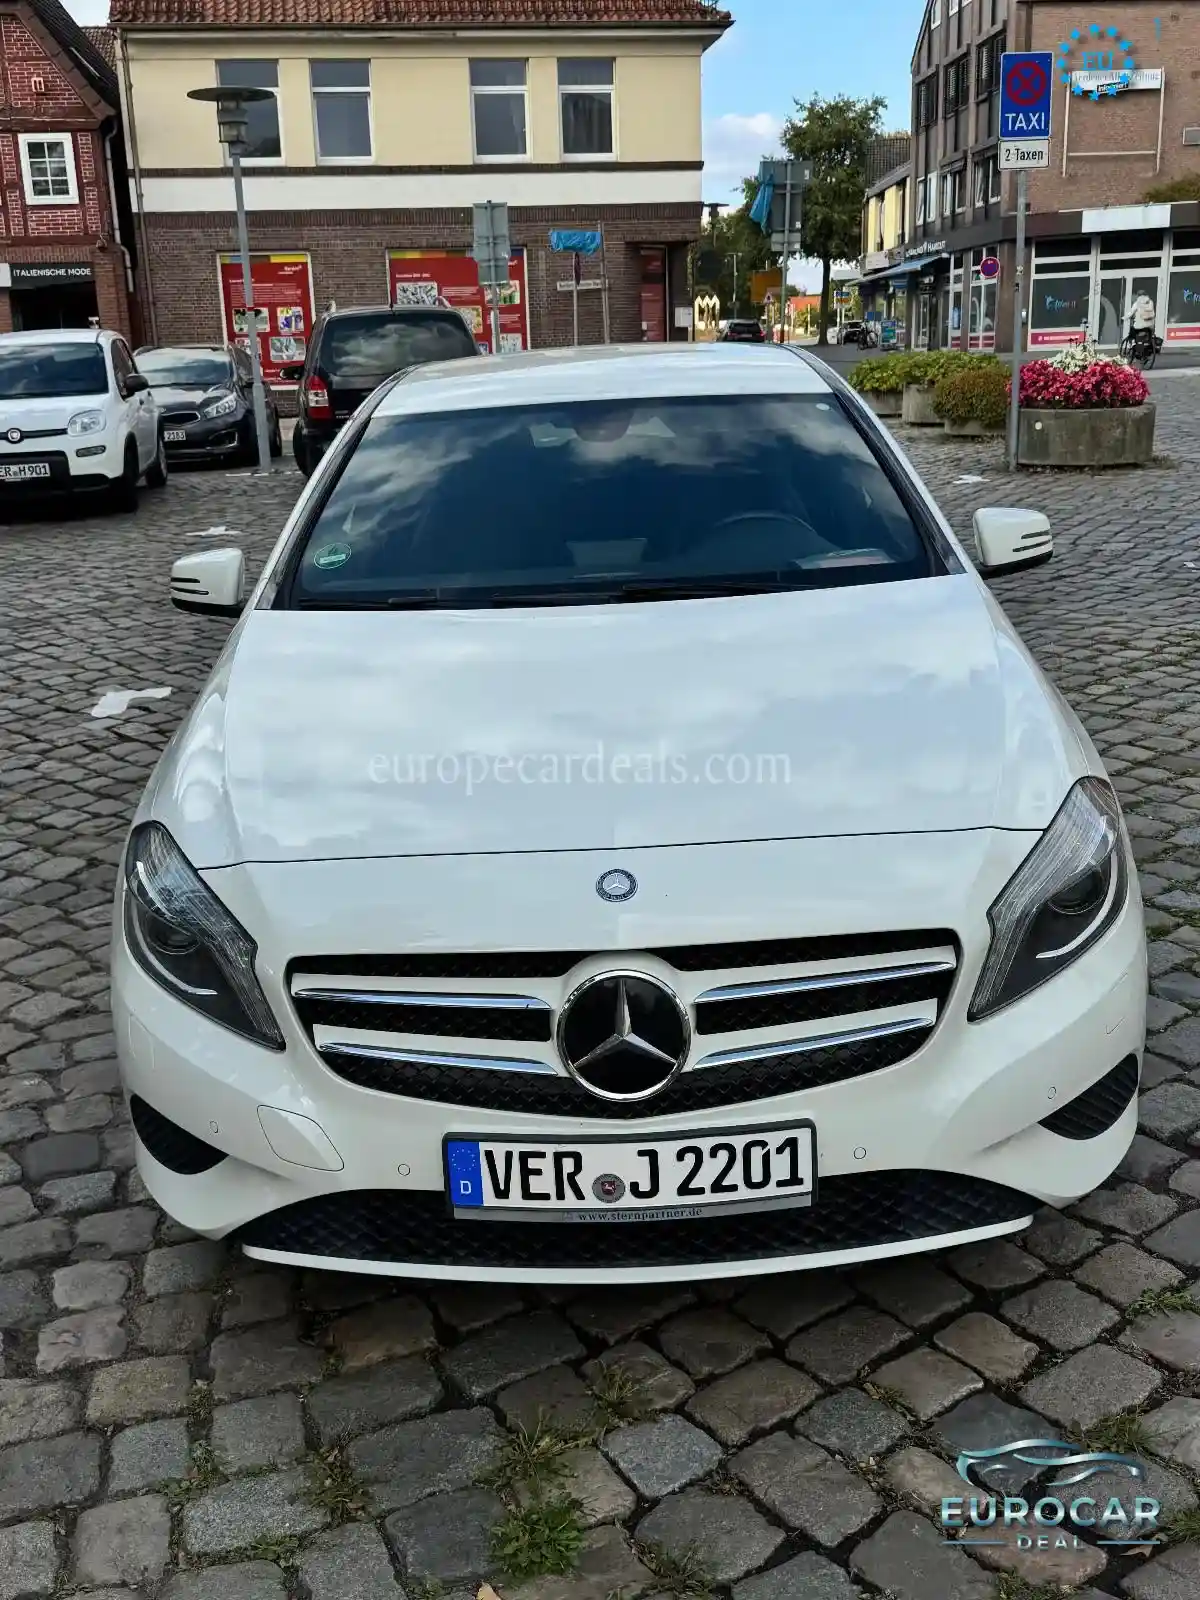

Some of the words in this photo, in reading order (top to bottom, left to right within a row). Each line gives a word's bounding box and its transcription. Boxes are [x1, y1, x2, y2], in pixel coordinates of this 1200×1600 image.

[1004, 112, 1045, 131] TAXI
[1005, 148, 1011, 161] 2
[1015, 148, 1044, 161] Taxen
[13, 268, 66, 277] ITALIENISCHE
[68, 268, 92, 276] MODE
[19, 465, 26, 476] H
[484, 1149, 586, 1201] VER
[629, 1148, 661, 1199] J
[676, 1136, 805, 1197] 2201
[460, 1180, 472, 1195] D
[578, 1207, 703, 1222] www.sternpartner.de
